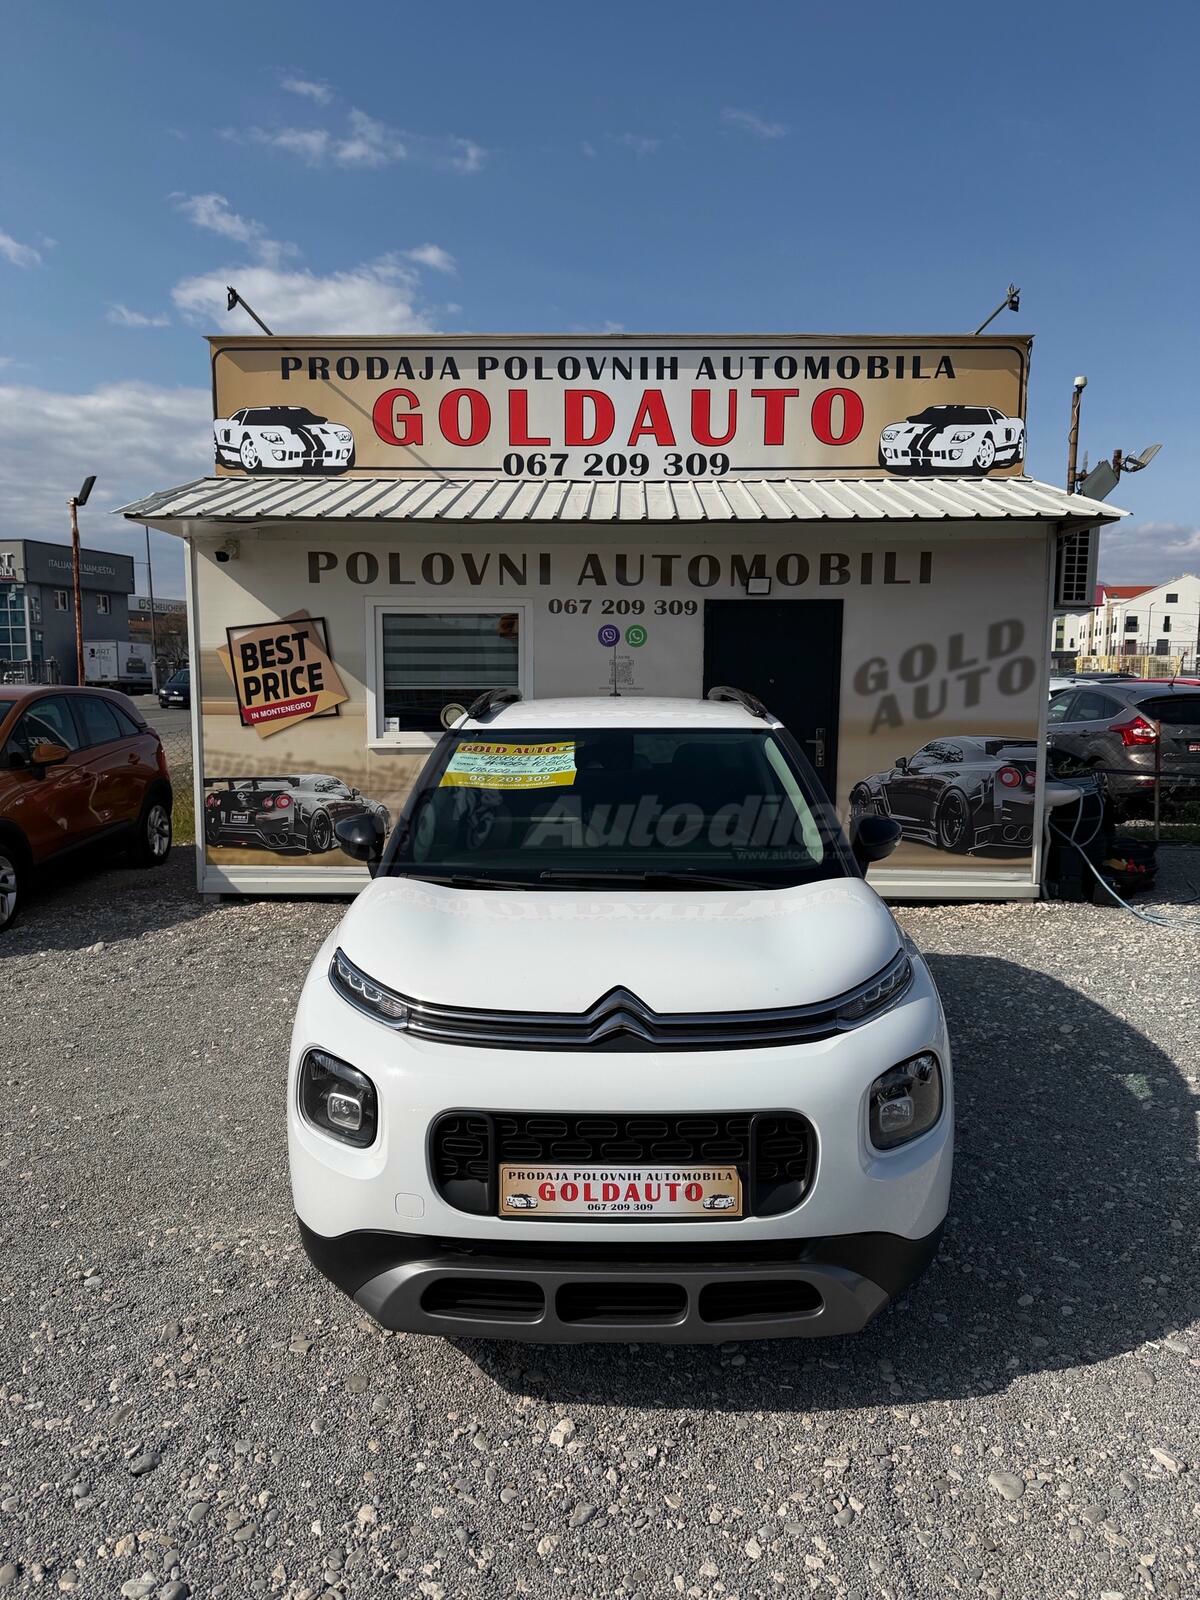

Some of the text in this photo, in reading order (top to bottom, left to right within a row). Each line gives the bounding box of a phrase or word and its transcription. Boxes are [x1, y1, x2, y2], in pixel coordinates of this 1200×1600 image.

[280, 354, 957, 381] PRODAJA POLOVNIH AUTOMOBILA
[371, 386, 865, 448] GOLDAUTO
[503, 453, 731, 477] 067 209 309
[307, 551, 933, 588] POLOVNI AUTOMOBILI
[548, 599, 699, 616] 067 209 309
[240, 630, 309, 673] BEST
[853, 618, 1025, 697] GOLD
[244, 661, 325, 706] PRICE
[869, 655, 1037, 735] AUTO
[251, 701, 312, 720] IN MONTENEGRO
[461, 745, 557, 754] GOLD AUTO
[508, 1171, 732, 1181] PRODAJA POLOVNIH AUTOMOBILA
[538, 1182, 704, 1203] GOLDAUTO
[587, 1203, 653, 1211] 067 209 309
